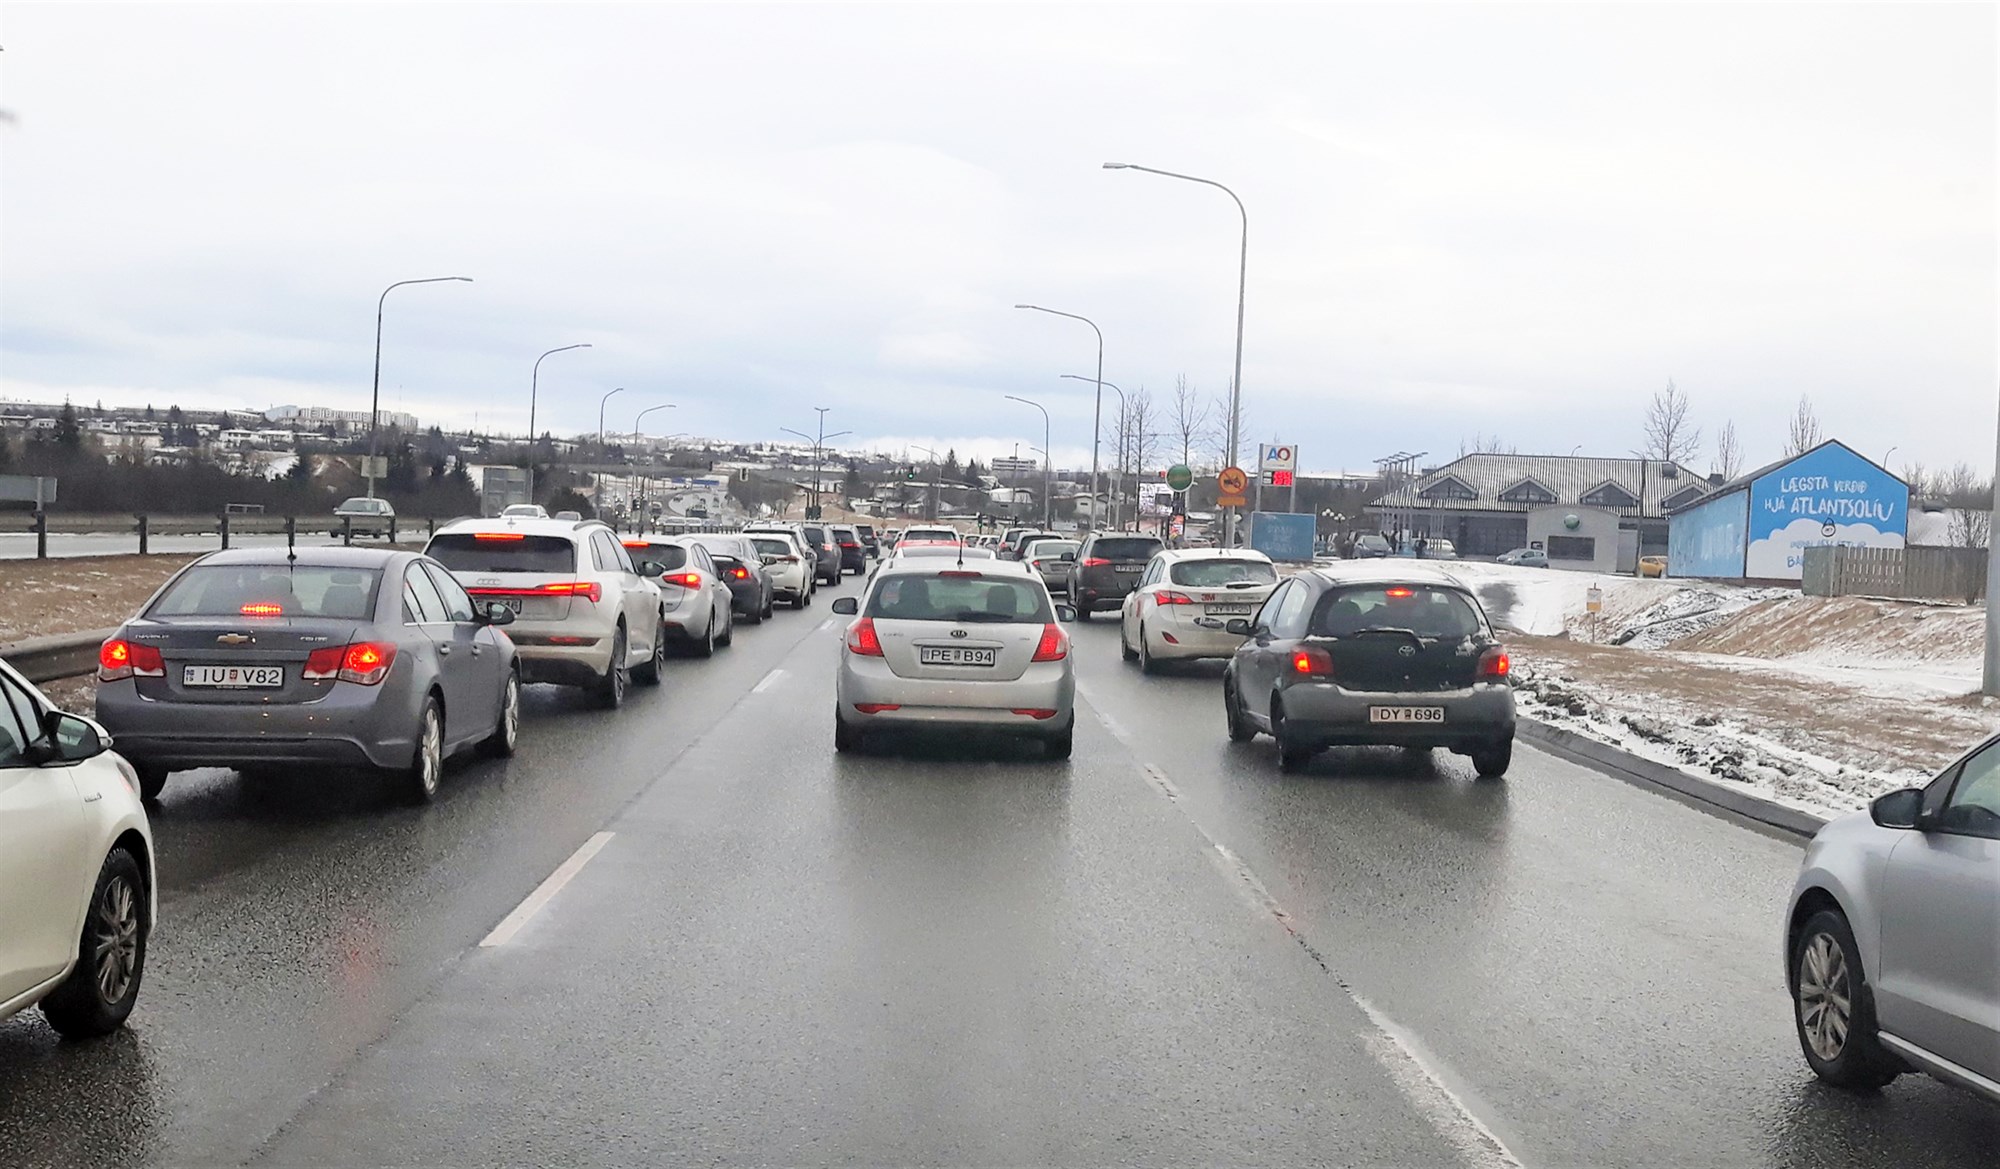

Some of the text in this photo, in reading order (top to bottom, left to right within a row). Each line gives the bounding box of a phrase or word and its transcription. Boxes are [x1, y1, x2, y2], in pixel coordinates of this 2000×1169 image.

[1266, 447, 1291, 461] AO
[1781, 476, 1829, 493] LÆGSTA
[1764, 495, 1894, 522] HJÁ ATLANTSOLÍU
[1201, 593, 1216, 602] 3M
[952, 630, 966, 638] KIA
[931, 650, 992, 662] PE B94
[203, 669, 280, 684] IU V82
[1380, 709, 1441, 720] DY 696
